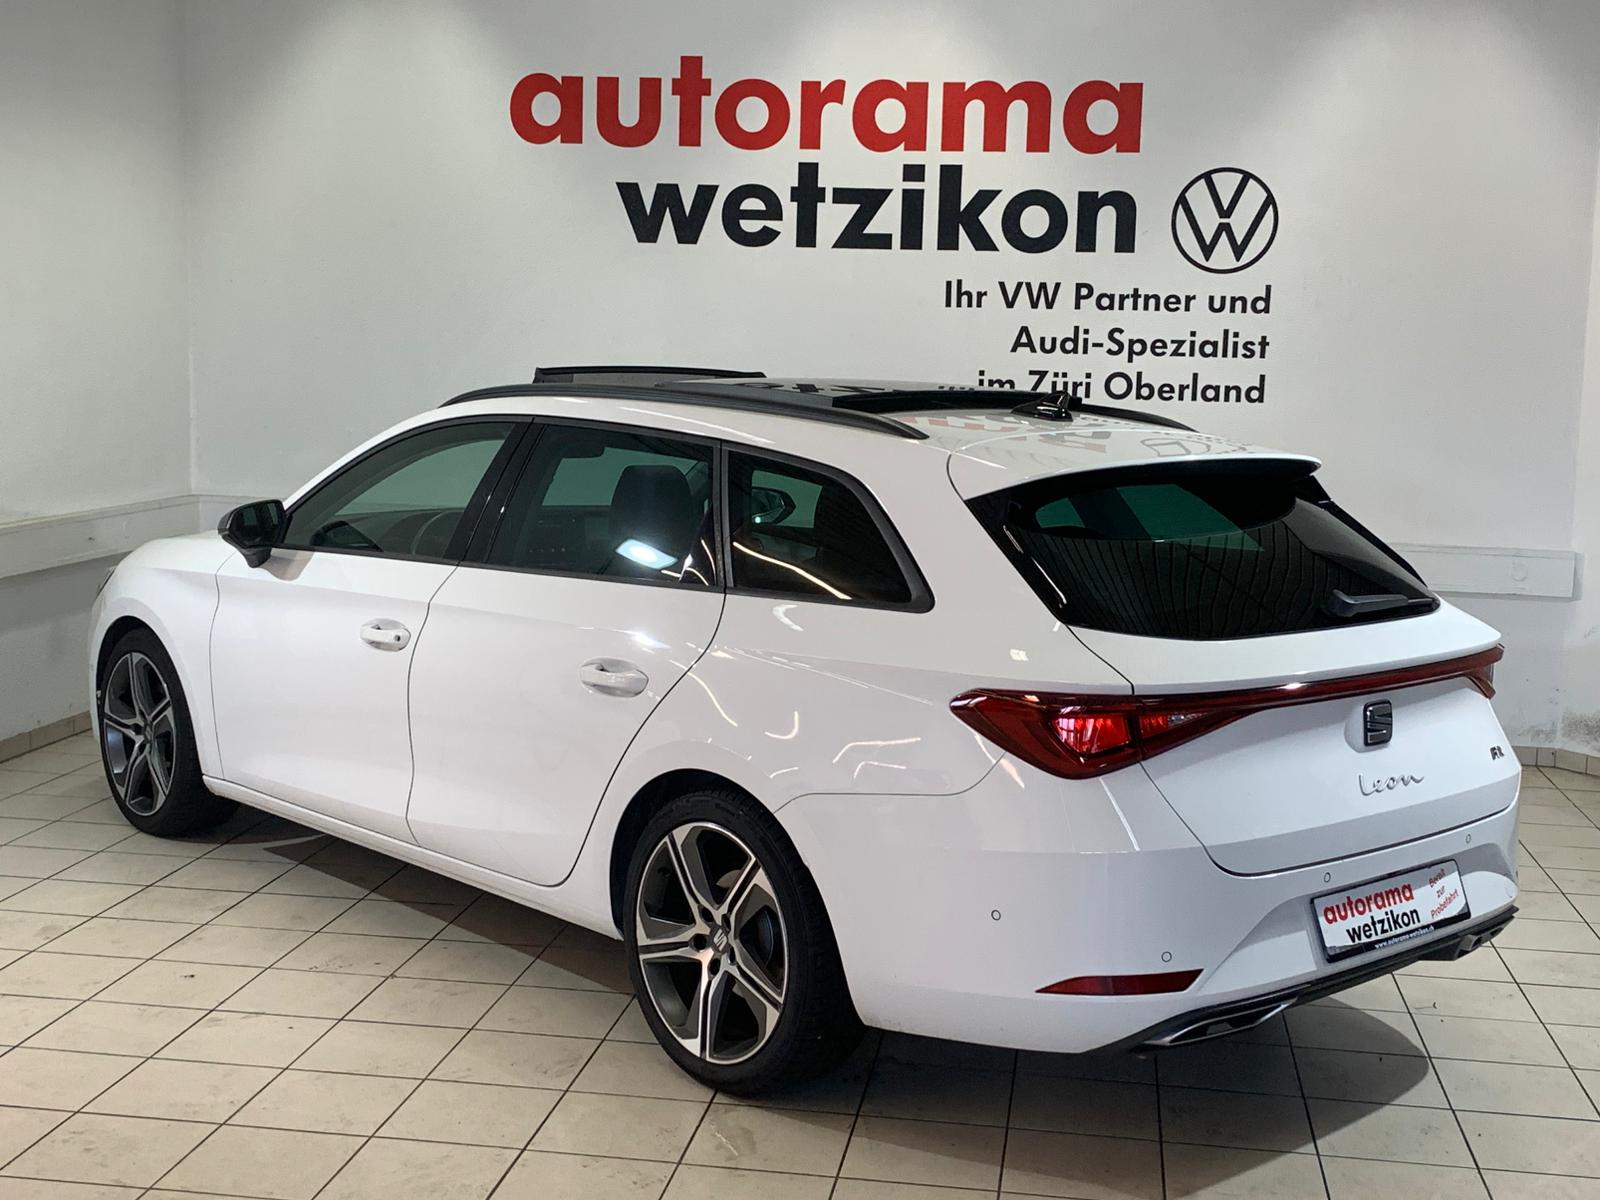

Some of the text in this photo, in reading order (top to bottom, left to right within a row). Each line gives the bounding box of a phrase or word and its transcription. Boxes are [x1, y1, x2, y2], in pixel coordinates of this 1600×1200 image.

[510, 56, 1143, 154] autorama
[616, 162, 1136, 253] wetzikon
[946, 279, 1271, 314] Ihr VW Partner und
[1010, 326, 1269, 363] Audi-Spezialist
[1105, 372, 1265, 403] Oberland
[1358, 773, 1424, 796] Leon
[1323, 883, 1415, 924] autorama
[1431, 889, 1458, 918] Probefahrt
[1346, 908, 1421, 943] wetzikon
